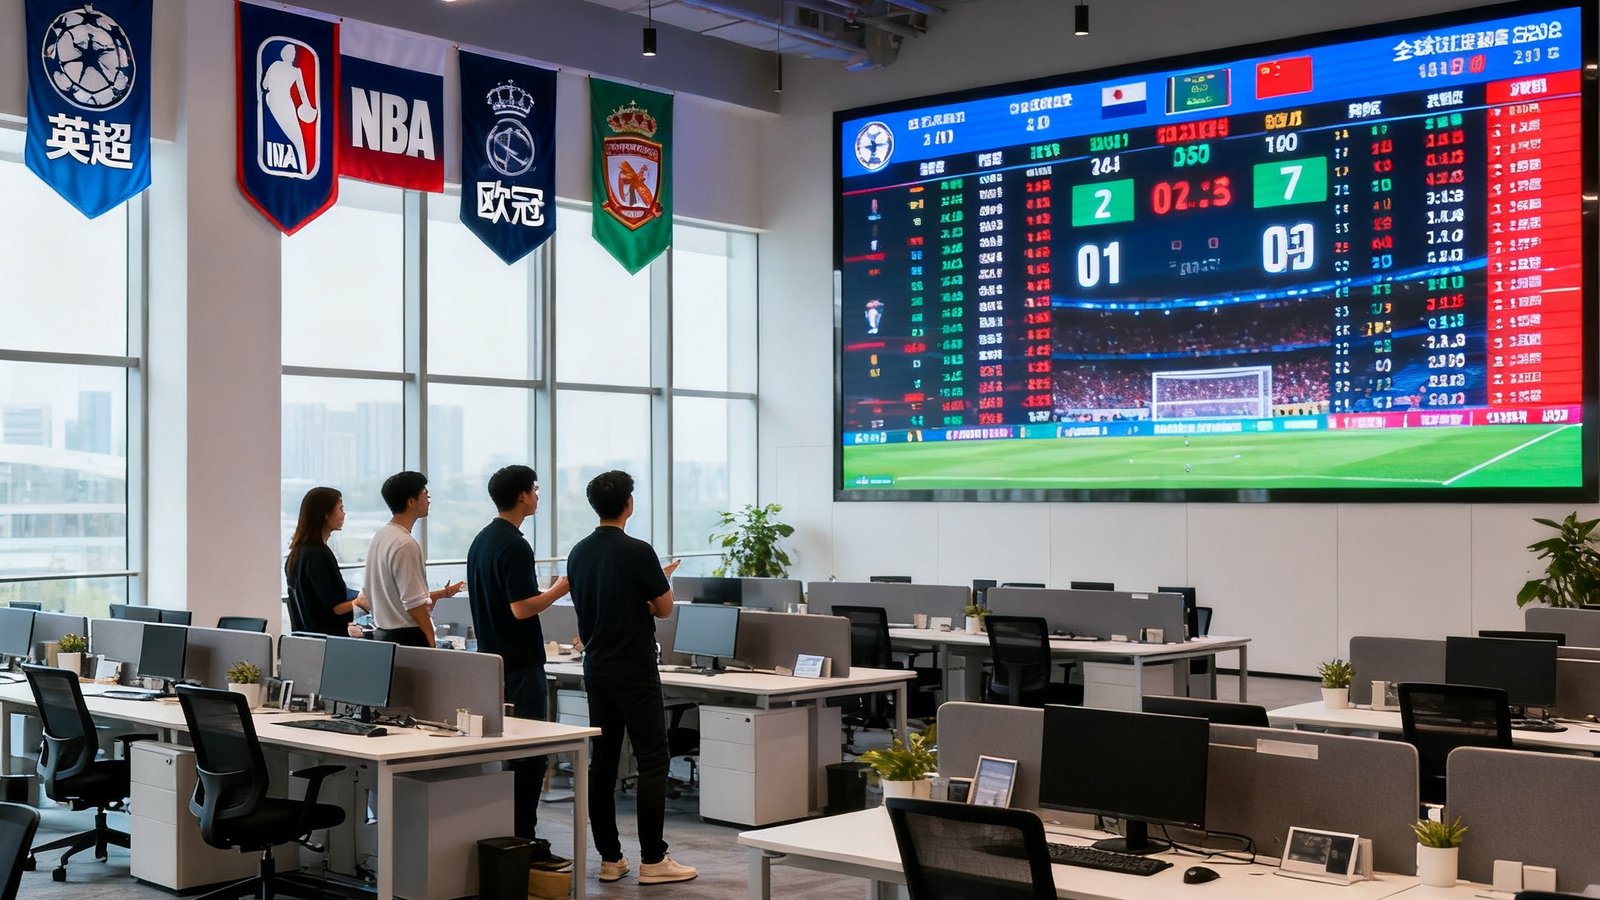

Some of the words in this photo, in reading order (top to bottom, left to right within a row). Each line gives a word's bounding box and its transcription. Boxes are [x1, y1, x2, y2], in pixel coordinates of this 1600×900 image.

[46, 113, 133, 169] 英超
[351, 86, 435, 161] NBA
[477, 180, 545, 227] 欧冠
[1094, 188, 1112, 219] 2
[1280, 165, 1303, 200] 7
[1077, 241, 1120, 288] 01
